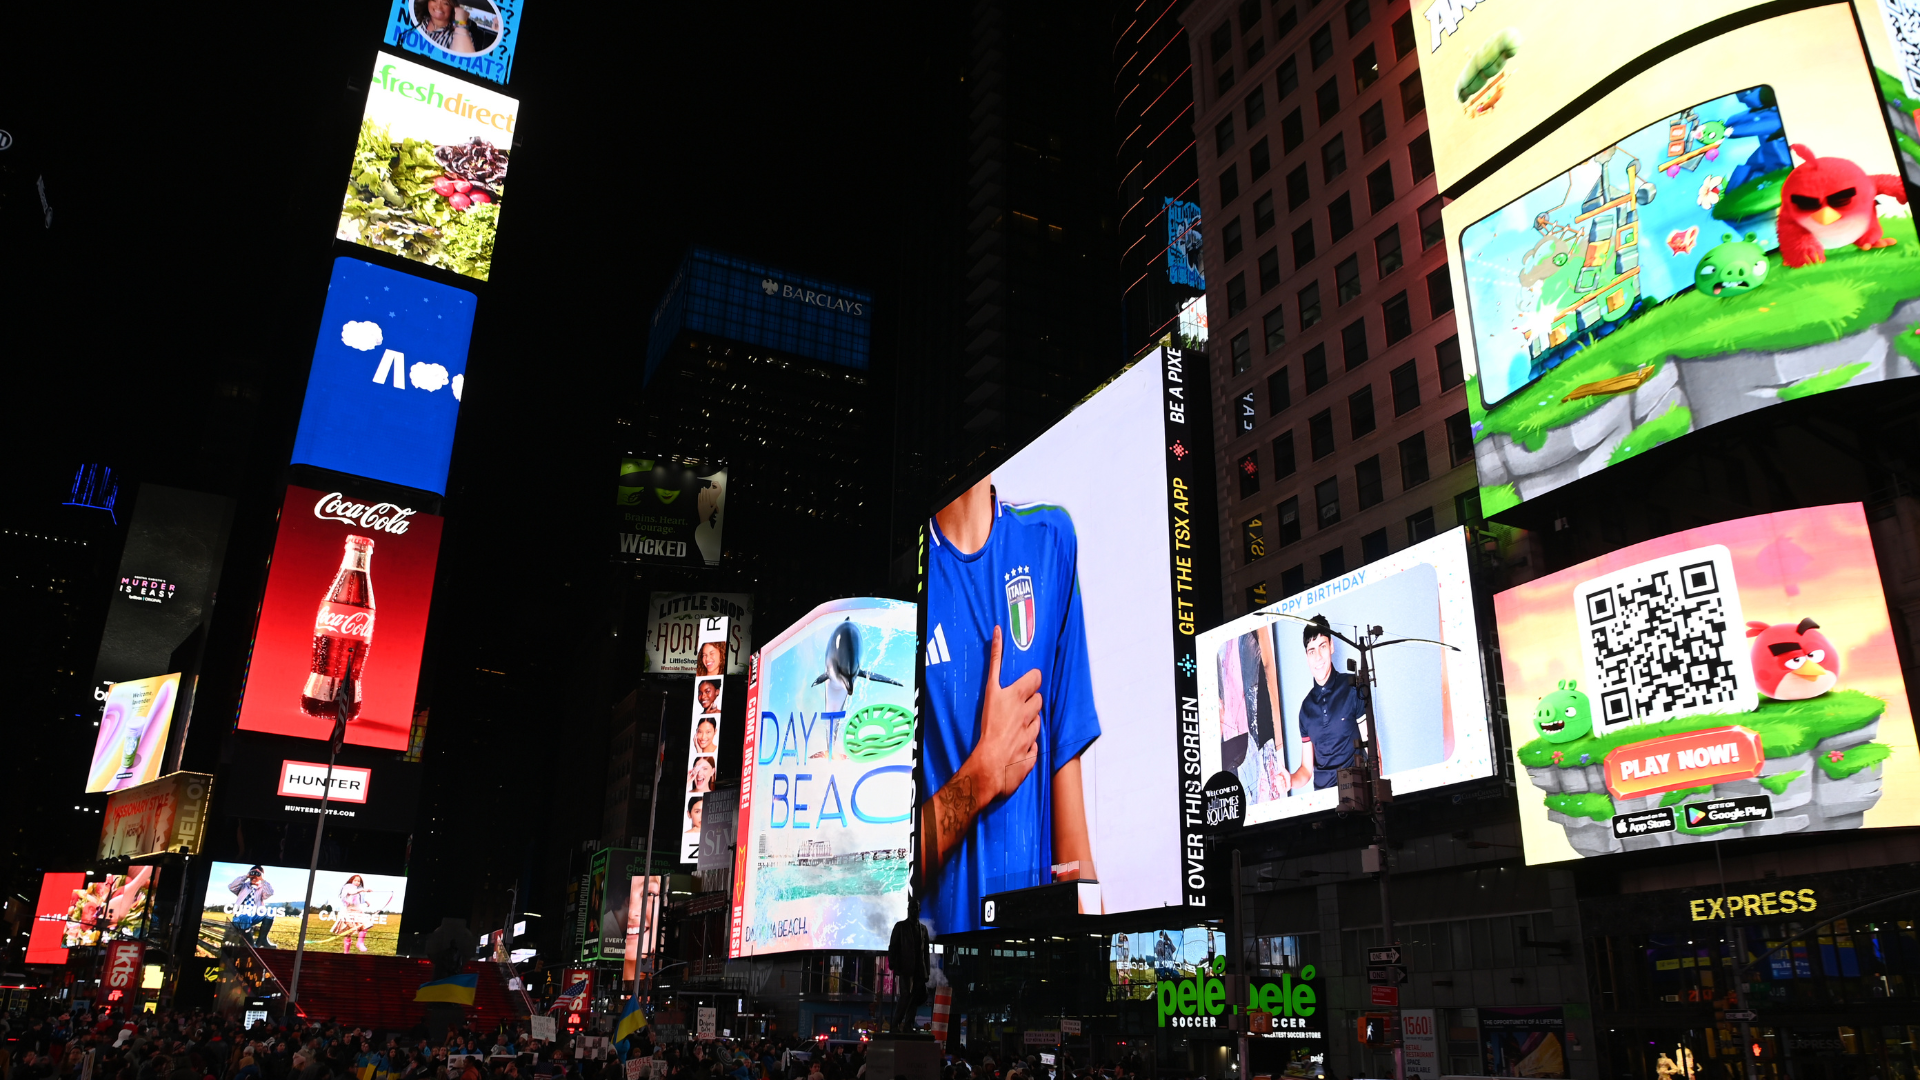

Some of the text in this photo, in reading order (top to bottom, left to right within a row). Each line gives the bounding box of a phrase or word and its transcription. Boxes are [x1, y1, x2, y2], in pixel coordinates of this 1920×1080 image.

[378, 64, 515, 133] freshdirect
[783, 285, 863, 316] BARCLAYS
[1174, 387, 1184, 400] A
[1169, 401, 1185, 424] BE
[314, 491, 417, 535] Coca-Cola
[625, 513, 689, 526] Brains. Heart.
[635, 522, 676, 535] Courage.
[1172, 477, 1195, 635] GET THE TSX APP
[119, 585, 132, 593] IS
[141, 587, 174, 599] EASY
[121, 577, 176, 592] MURDER
[1008, 580, 1031, 600] ITALIA
[1306, 569, 1366, 606] BIRTHDAY
[659, 595, 745, 621] LITTLE SHOP
[745, 697, 757, 744] COME
[1181, 696, 1201, 776] SCREEN
[1620, 742, 1740, 781] PLAY NOW!
[289, 774, 361, 790] HUNTER
[741, 748, 753, 809] INSIDE!
[1231, 784, 1239, 792] TO
[113, 799, 149, 819] MISSIONARY
[1184, 781, 1203, 828] THIS
[1219, 795, 1239, 808] TIMES
[1206, 804, 1240, 826] SQUARE
[1708, 806, 1767, 821] Google Play
[1629, 818, 1671, 833] App Store
[1187, 834, 1206, 890] OVER
[223, 903, 286, 919] CURIOUS
[1689, 888, 1818, 922] EXPRESS
[778, 917, 808, 938] BEACH.
[110, 944, 139, 988] tkts
[1372, 952, 1397, 961] ONE WAY
[1372, 971, 1385, 979] ONE
[1157, 954, 1226, 1028] pelé
[1172, 1016, 1217, 1028] SOCCER
[1403, 1016, 1428, 1035] 1560
